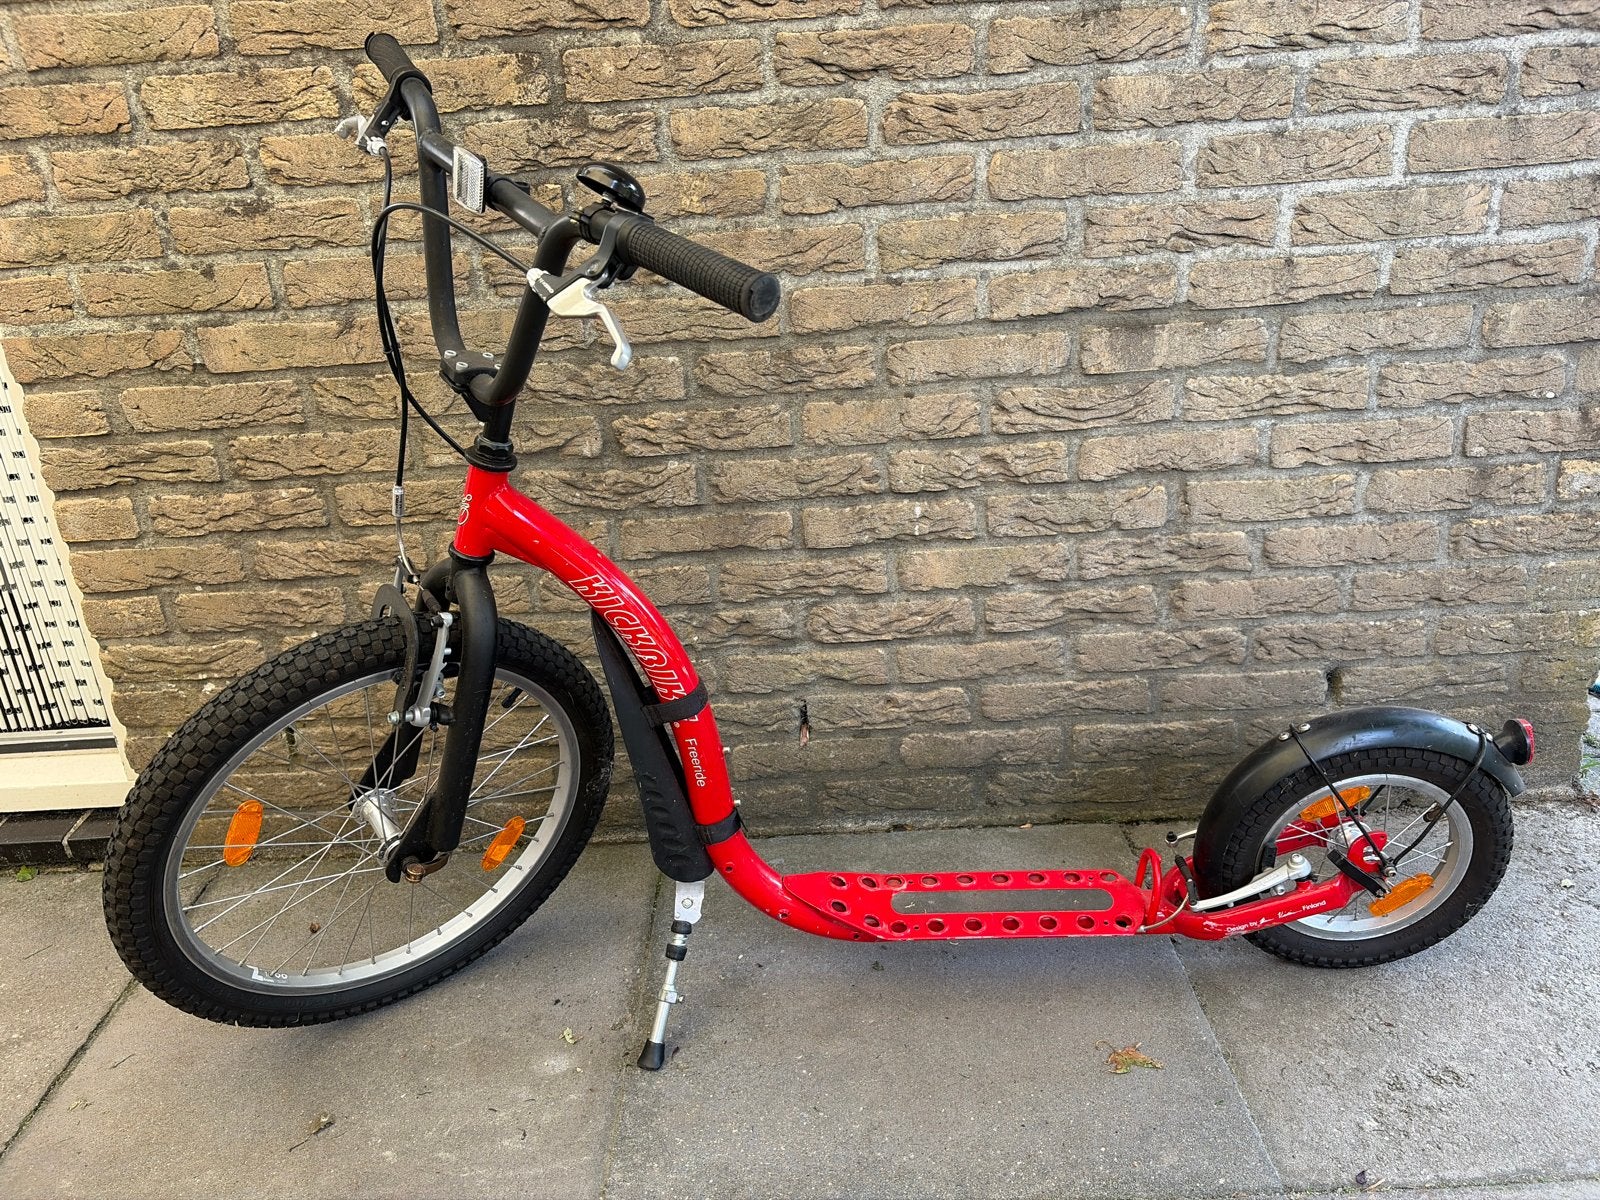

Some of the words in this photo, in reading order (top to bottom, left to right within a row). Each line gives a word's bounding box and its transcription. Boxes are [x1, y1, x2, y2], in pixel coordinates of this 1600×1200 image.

[685, 738, 706, 787] Freeride
[1303, 900, 1327, 911] Finland
[1226, 924, 1249, 933] Design
